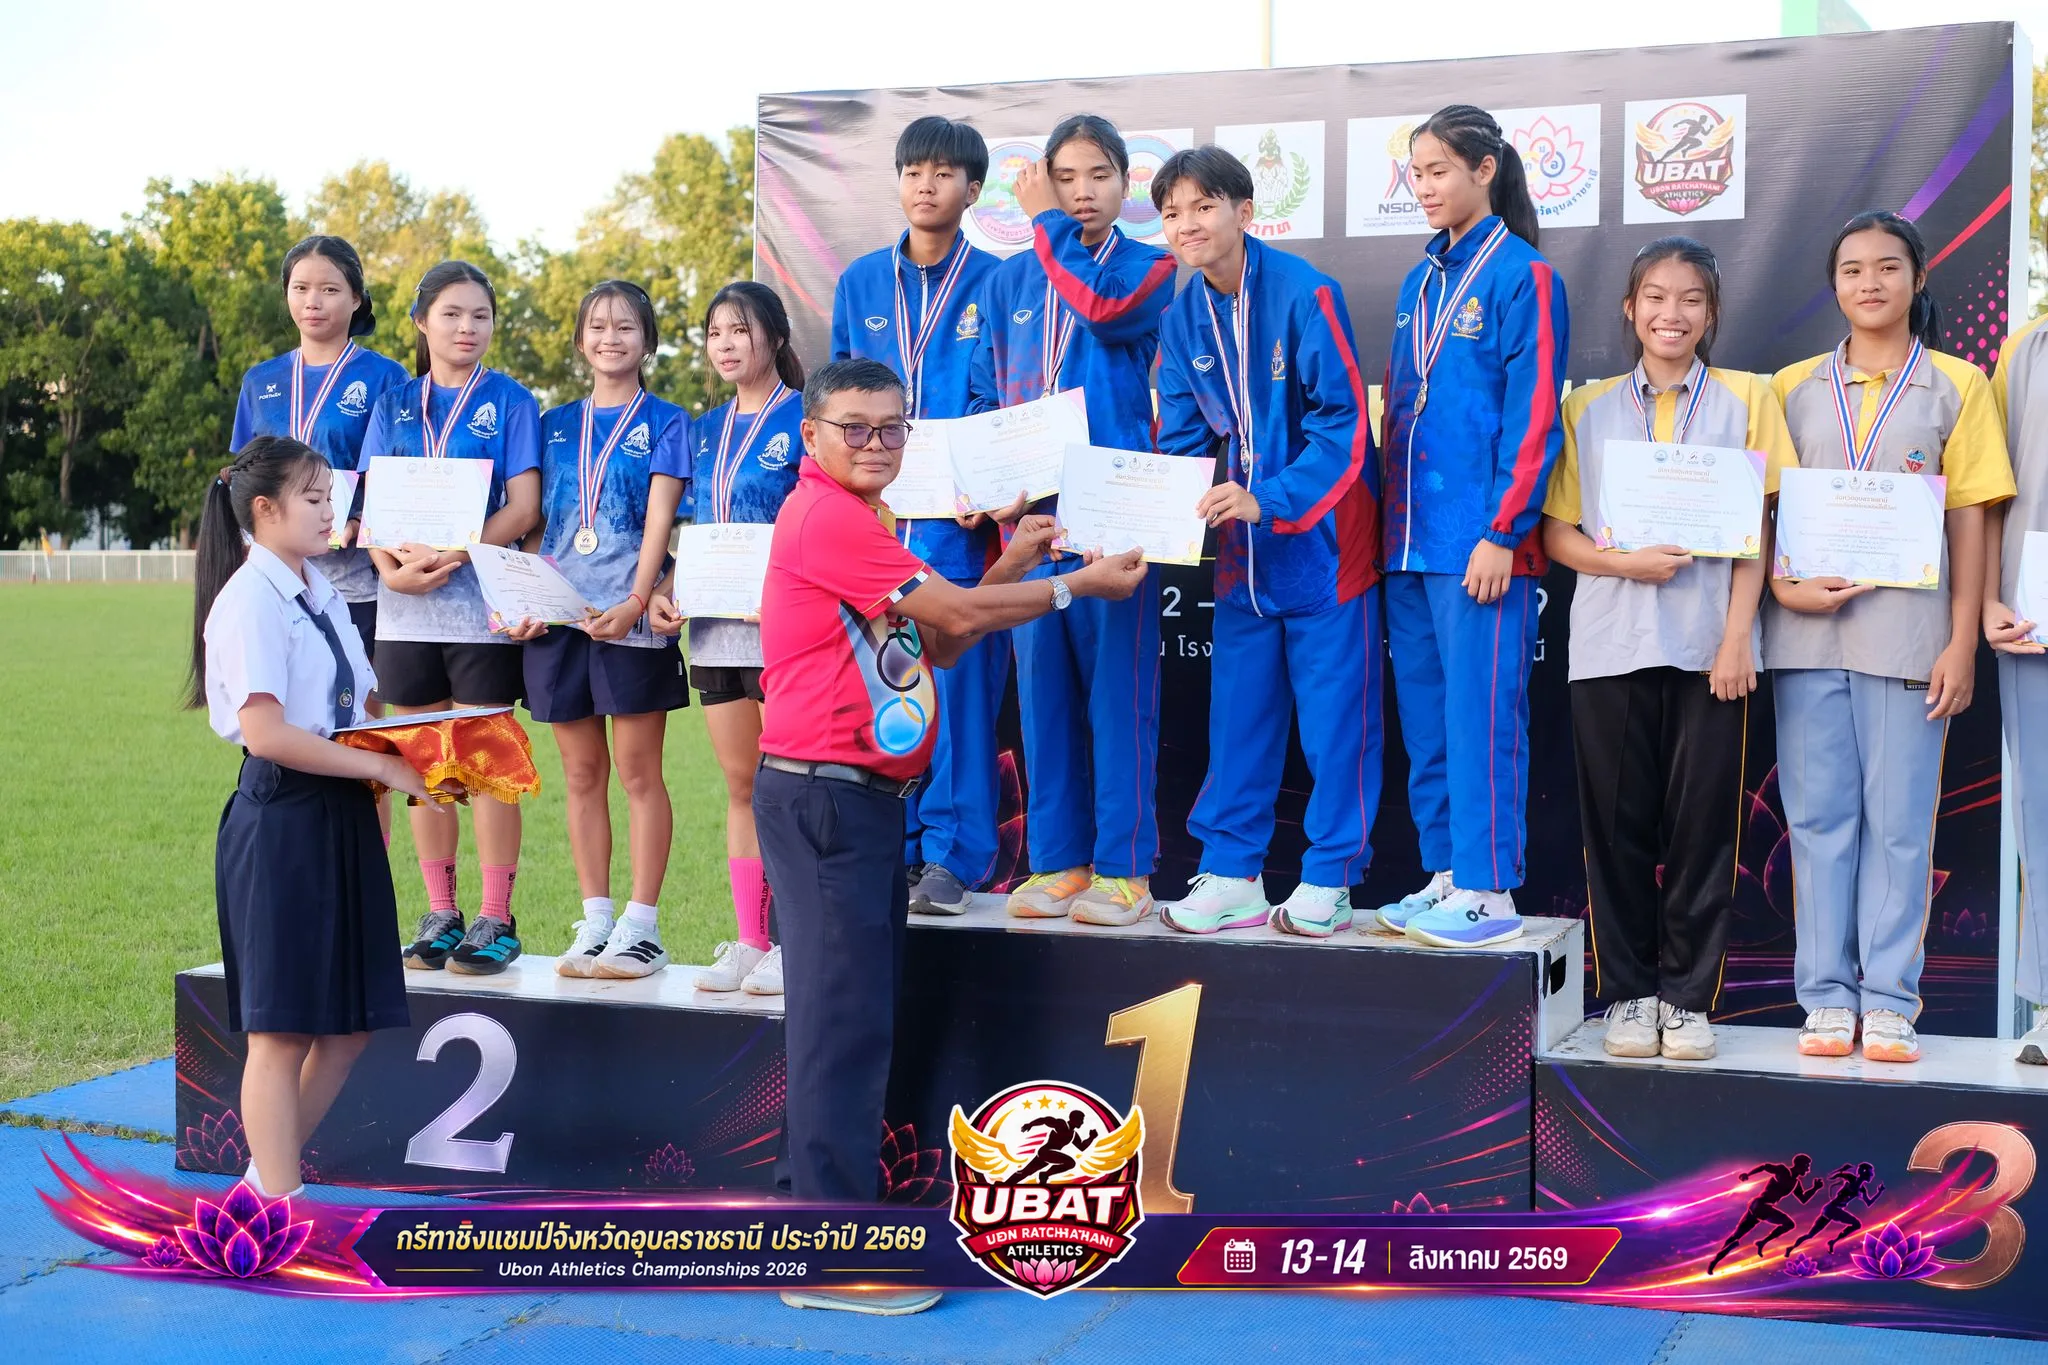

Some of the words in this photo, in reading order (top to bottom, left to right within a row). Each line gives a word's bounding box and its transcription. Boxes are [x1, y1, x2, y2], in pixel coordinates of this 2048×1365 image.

[1643, 159, 1727, 185] UBAT
[404, 1012, 518, 1174] 2
[1105, 982, 1203, 1215] 1
[1906, 1120, 2037, 1291] 3
